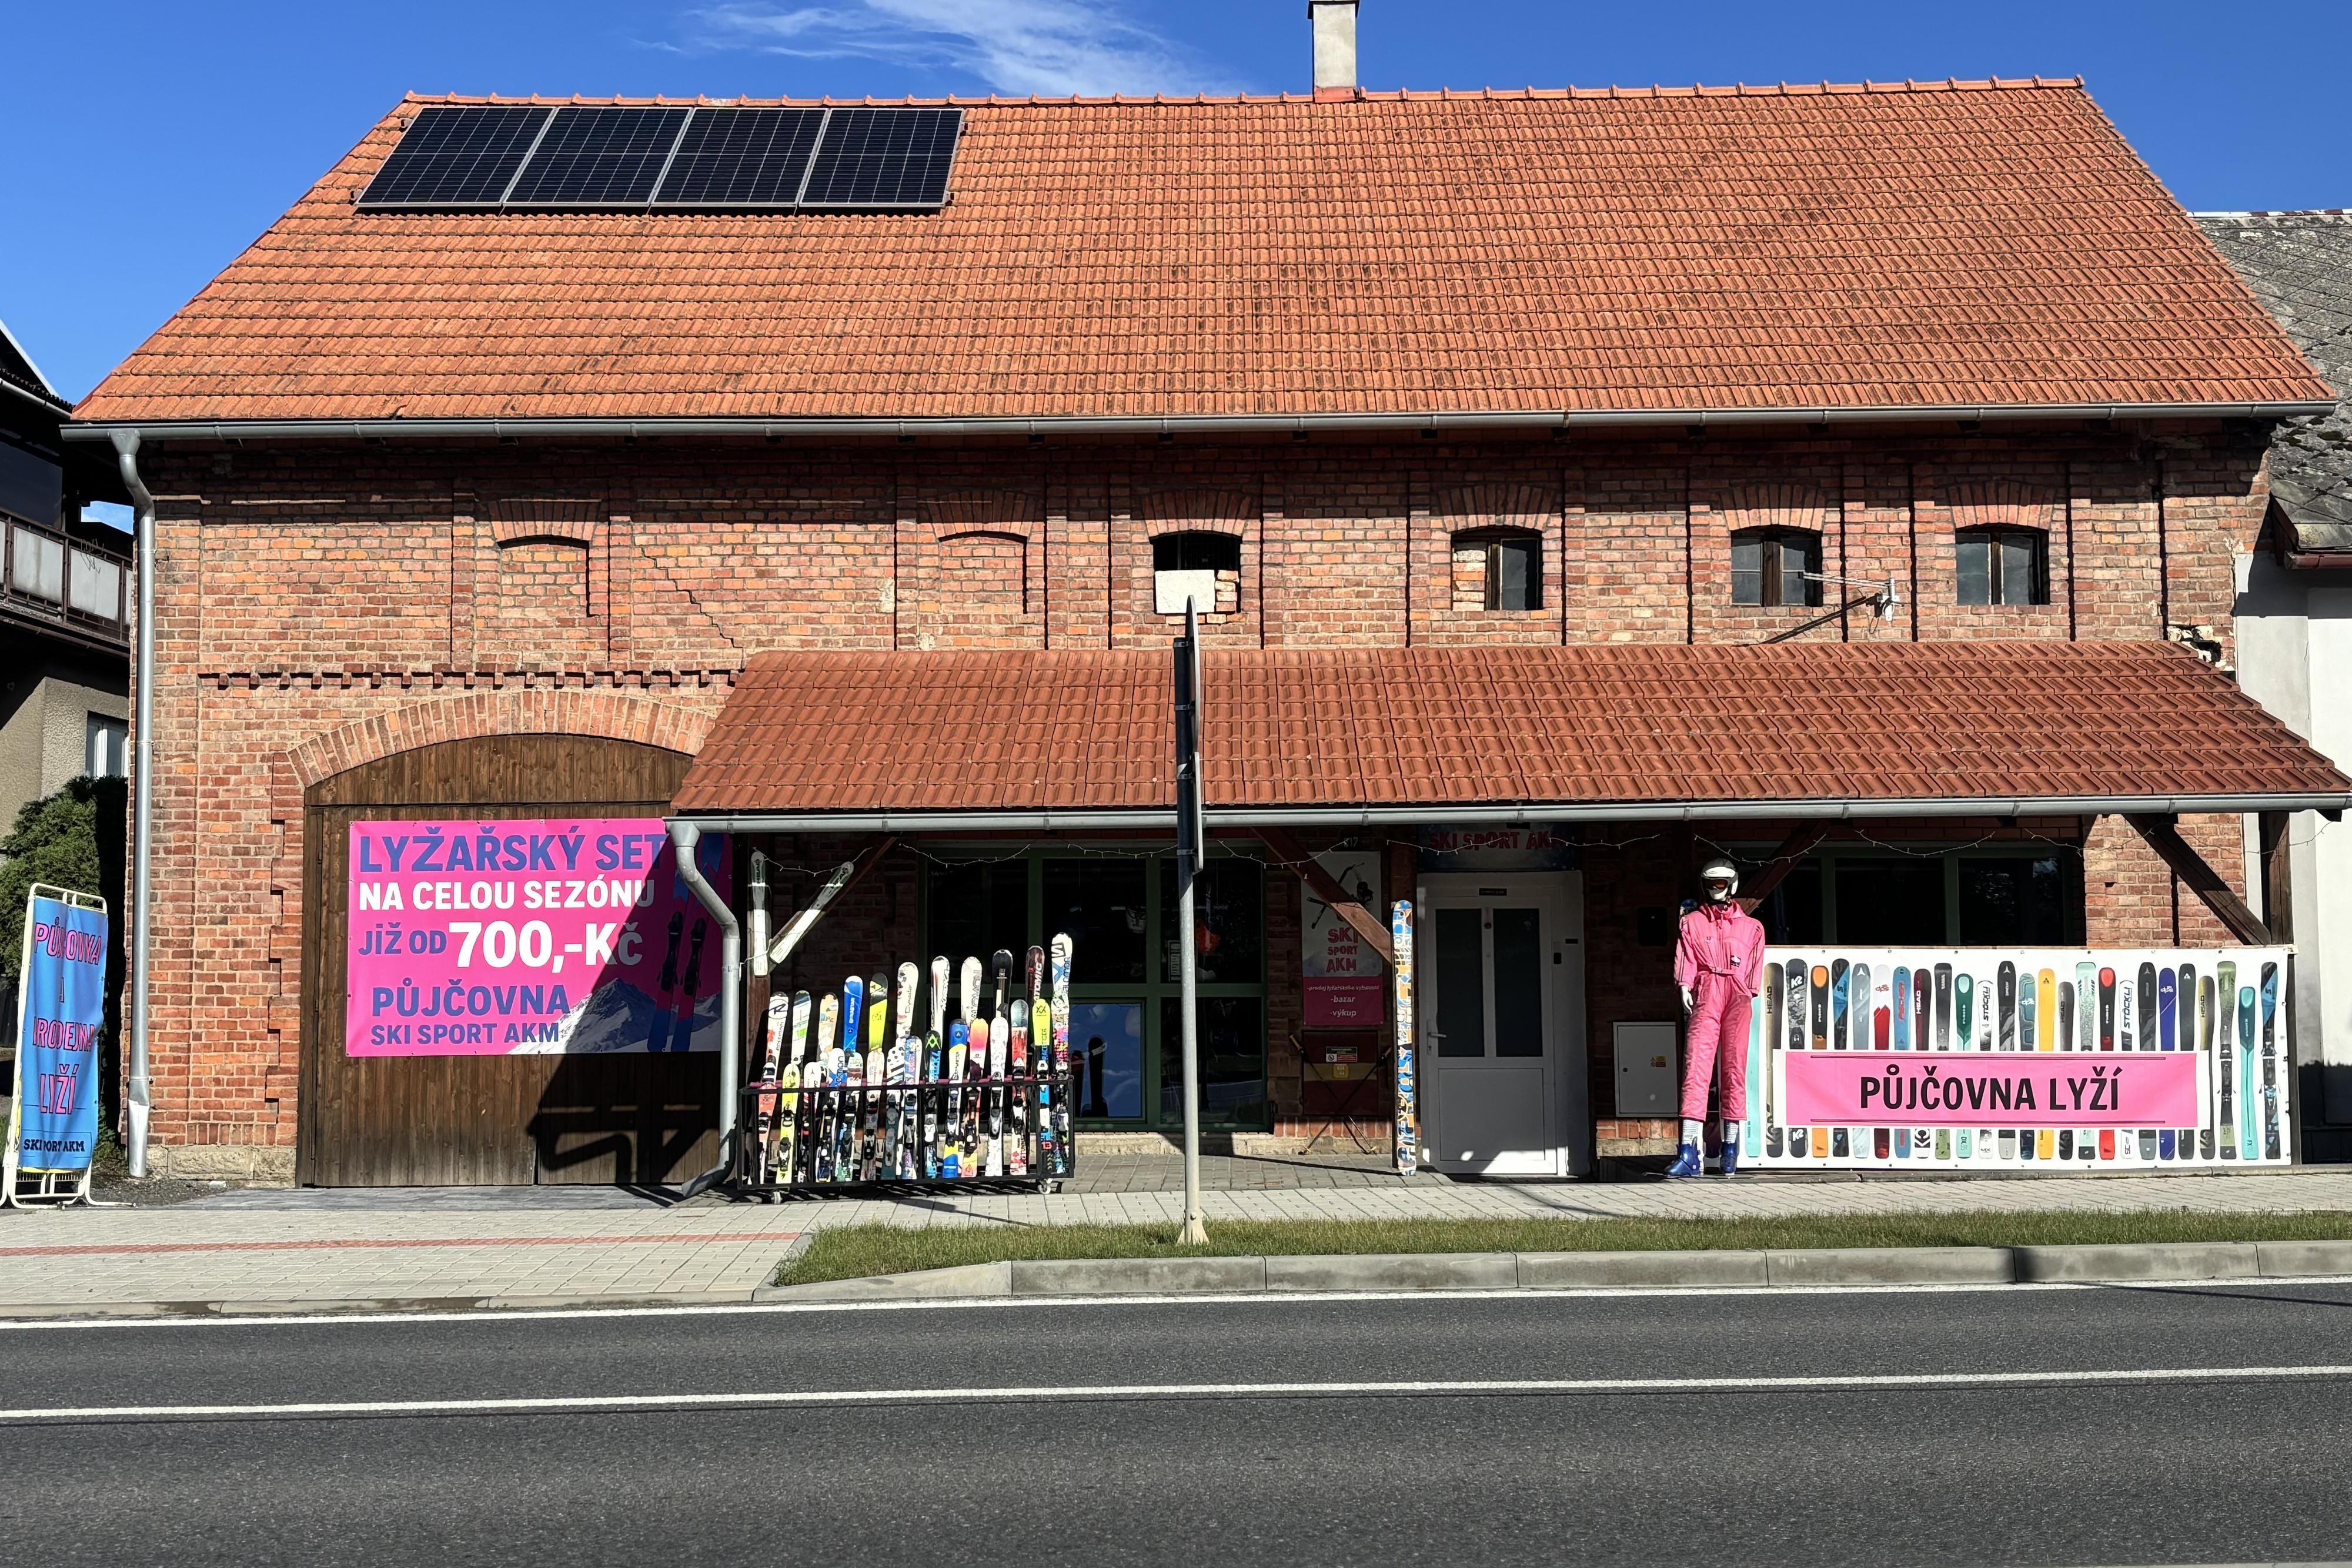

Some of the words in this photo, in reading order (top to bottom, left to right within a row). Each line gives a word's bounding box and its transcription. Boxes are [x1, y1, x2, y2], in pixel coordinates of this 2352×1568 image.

[360, 825, 586, 872] LYŽAŘSKÝ
[595, 834, 669, 871] SET
[1430, 831, 1458, 850] SKI
[359, 882, 405, 910] NA
[413, 881, 515, 910] CELOU
[523, 874, 654, 909] SEZÓNU
[409, 930, 447, 954] OD
[1328, 927, 1358, 944] SKI
[1327, 945, 1358, 955] SPORT
[1326, 958, 1357, 972] AKM
[1790, 975, 1803, 988] K2
[372, 977, 571, 1017] PŮJČOVNA
[371, 1025, 410, 1045] SKI
[417, 1023, 497, 1045] SPORT
[504, 1022, 559, 1044] AKM
[1860, 1064, 2037, 1111] PŮJČOVNA
[2049, 1065, 2123, 1111] LYŽÍ
[24, 1138, 42, 1151] SKI
[62, 1141, 85, 1152] AKM
